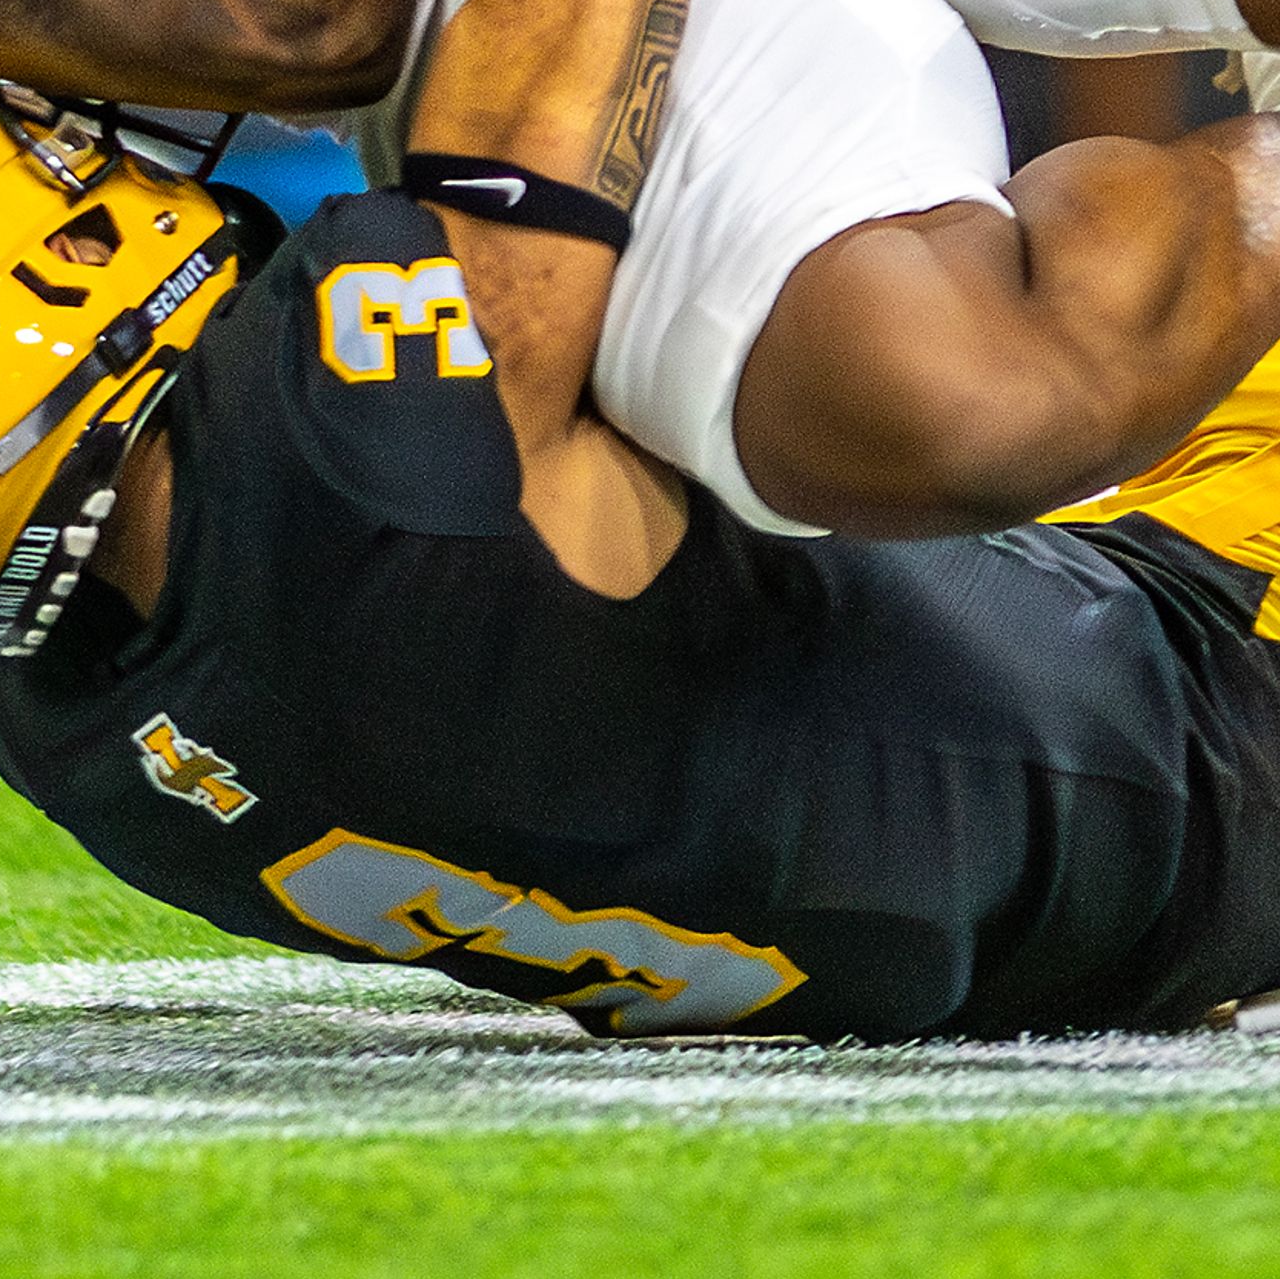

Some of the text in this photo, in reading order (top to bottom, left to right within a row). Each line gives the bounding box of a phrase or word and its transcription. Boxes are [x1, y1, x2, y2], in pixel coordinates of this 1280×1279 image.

[146, 251, 214, 325] schutt
[315, 257, 494, 384] 3
[2, 525, 60, 581] BOLD
